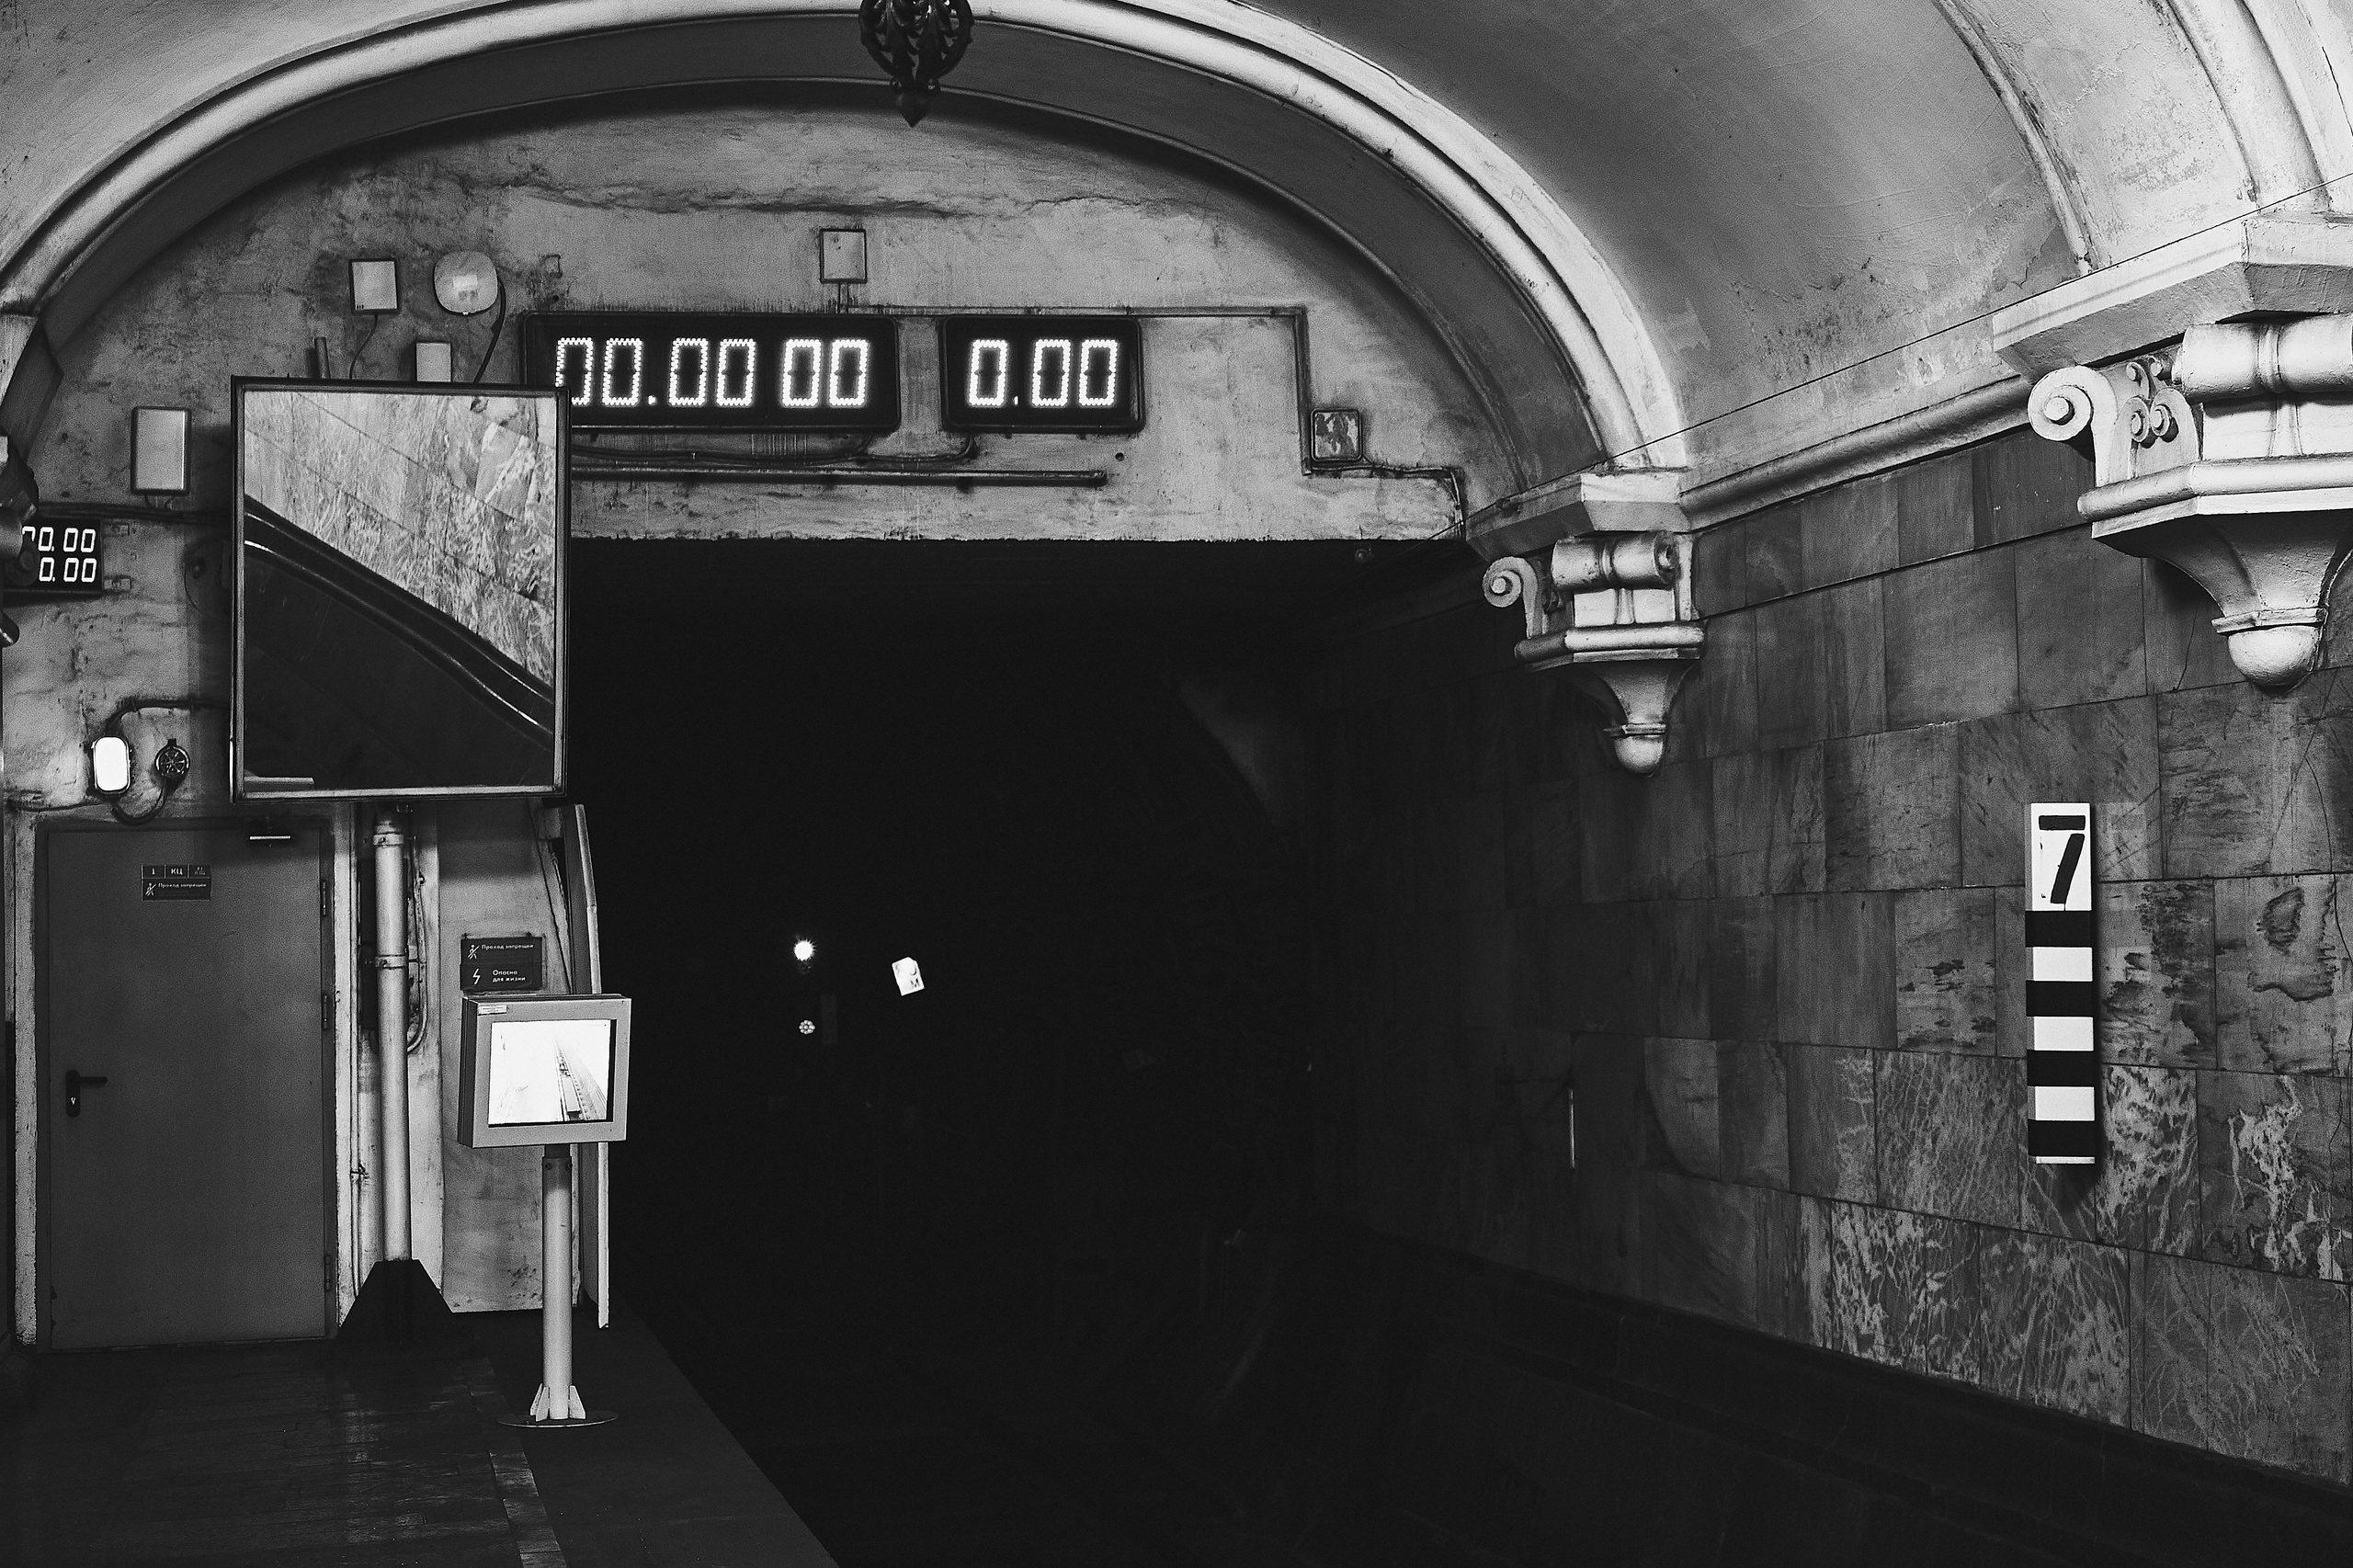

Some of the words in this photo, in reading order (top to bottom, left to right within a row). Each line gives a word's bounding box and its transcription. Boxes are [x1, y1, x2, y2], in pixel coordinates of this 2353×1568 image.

[780, 338, 869, 407] 00
[968, 339, 1119, 407] 0.00
[2038, 814, 2086, 905] 7
